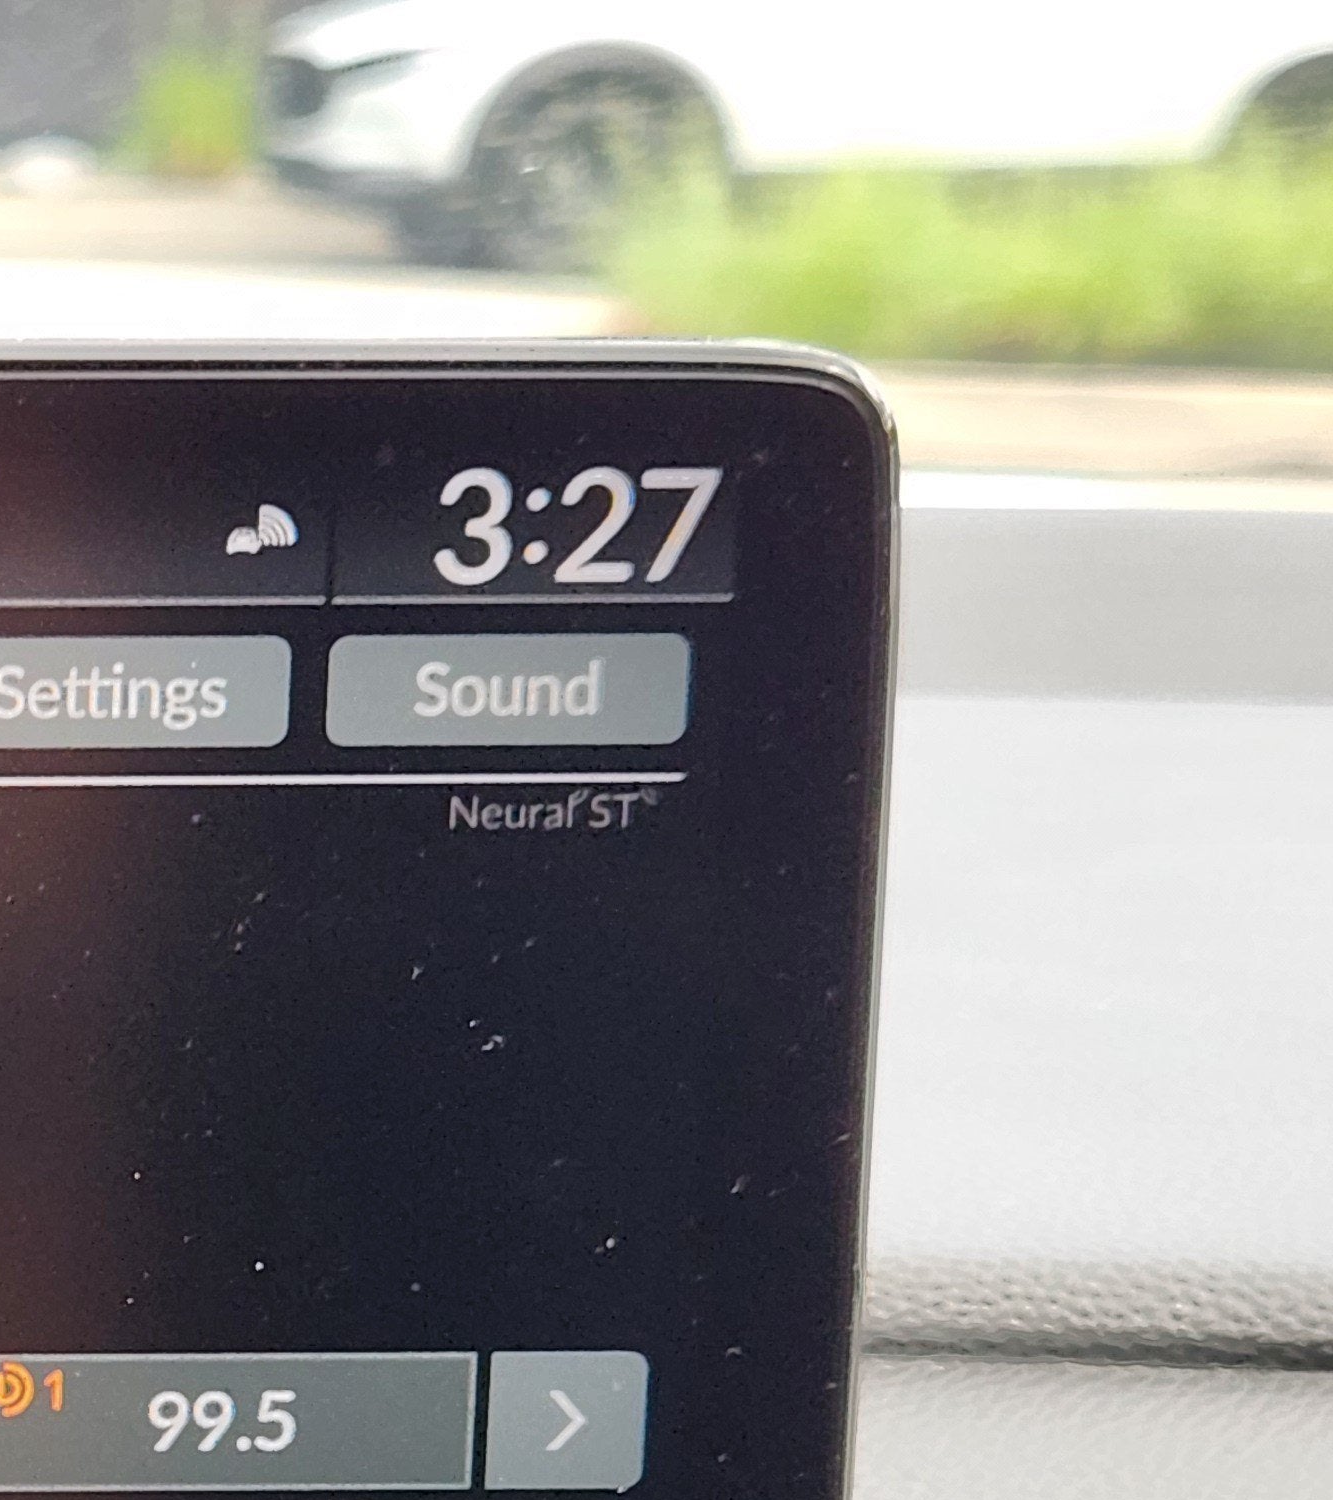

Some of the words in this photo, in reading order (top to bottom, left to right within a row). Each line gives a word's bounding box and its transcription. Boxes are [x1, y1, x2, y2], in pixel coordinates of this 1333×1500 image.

[433, 466, 723, 586] 3:27
[413, 659, 601, 717] Sound
[43, 1368, 64, 1412] 1
[147, 1389, 297, 1452] 99.5
